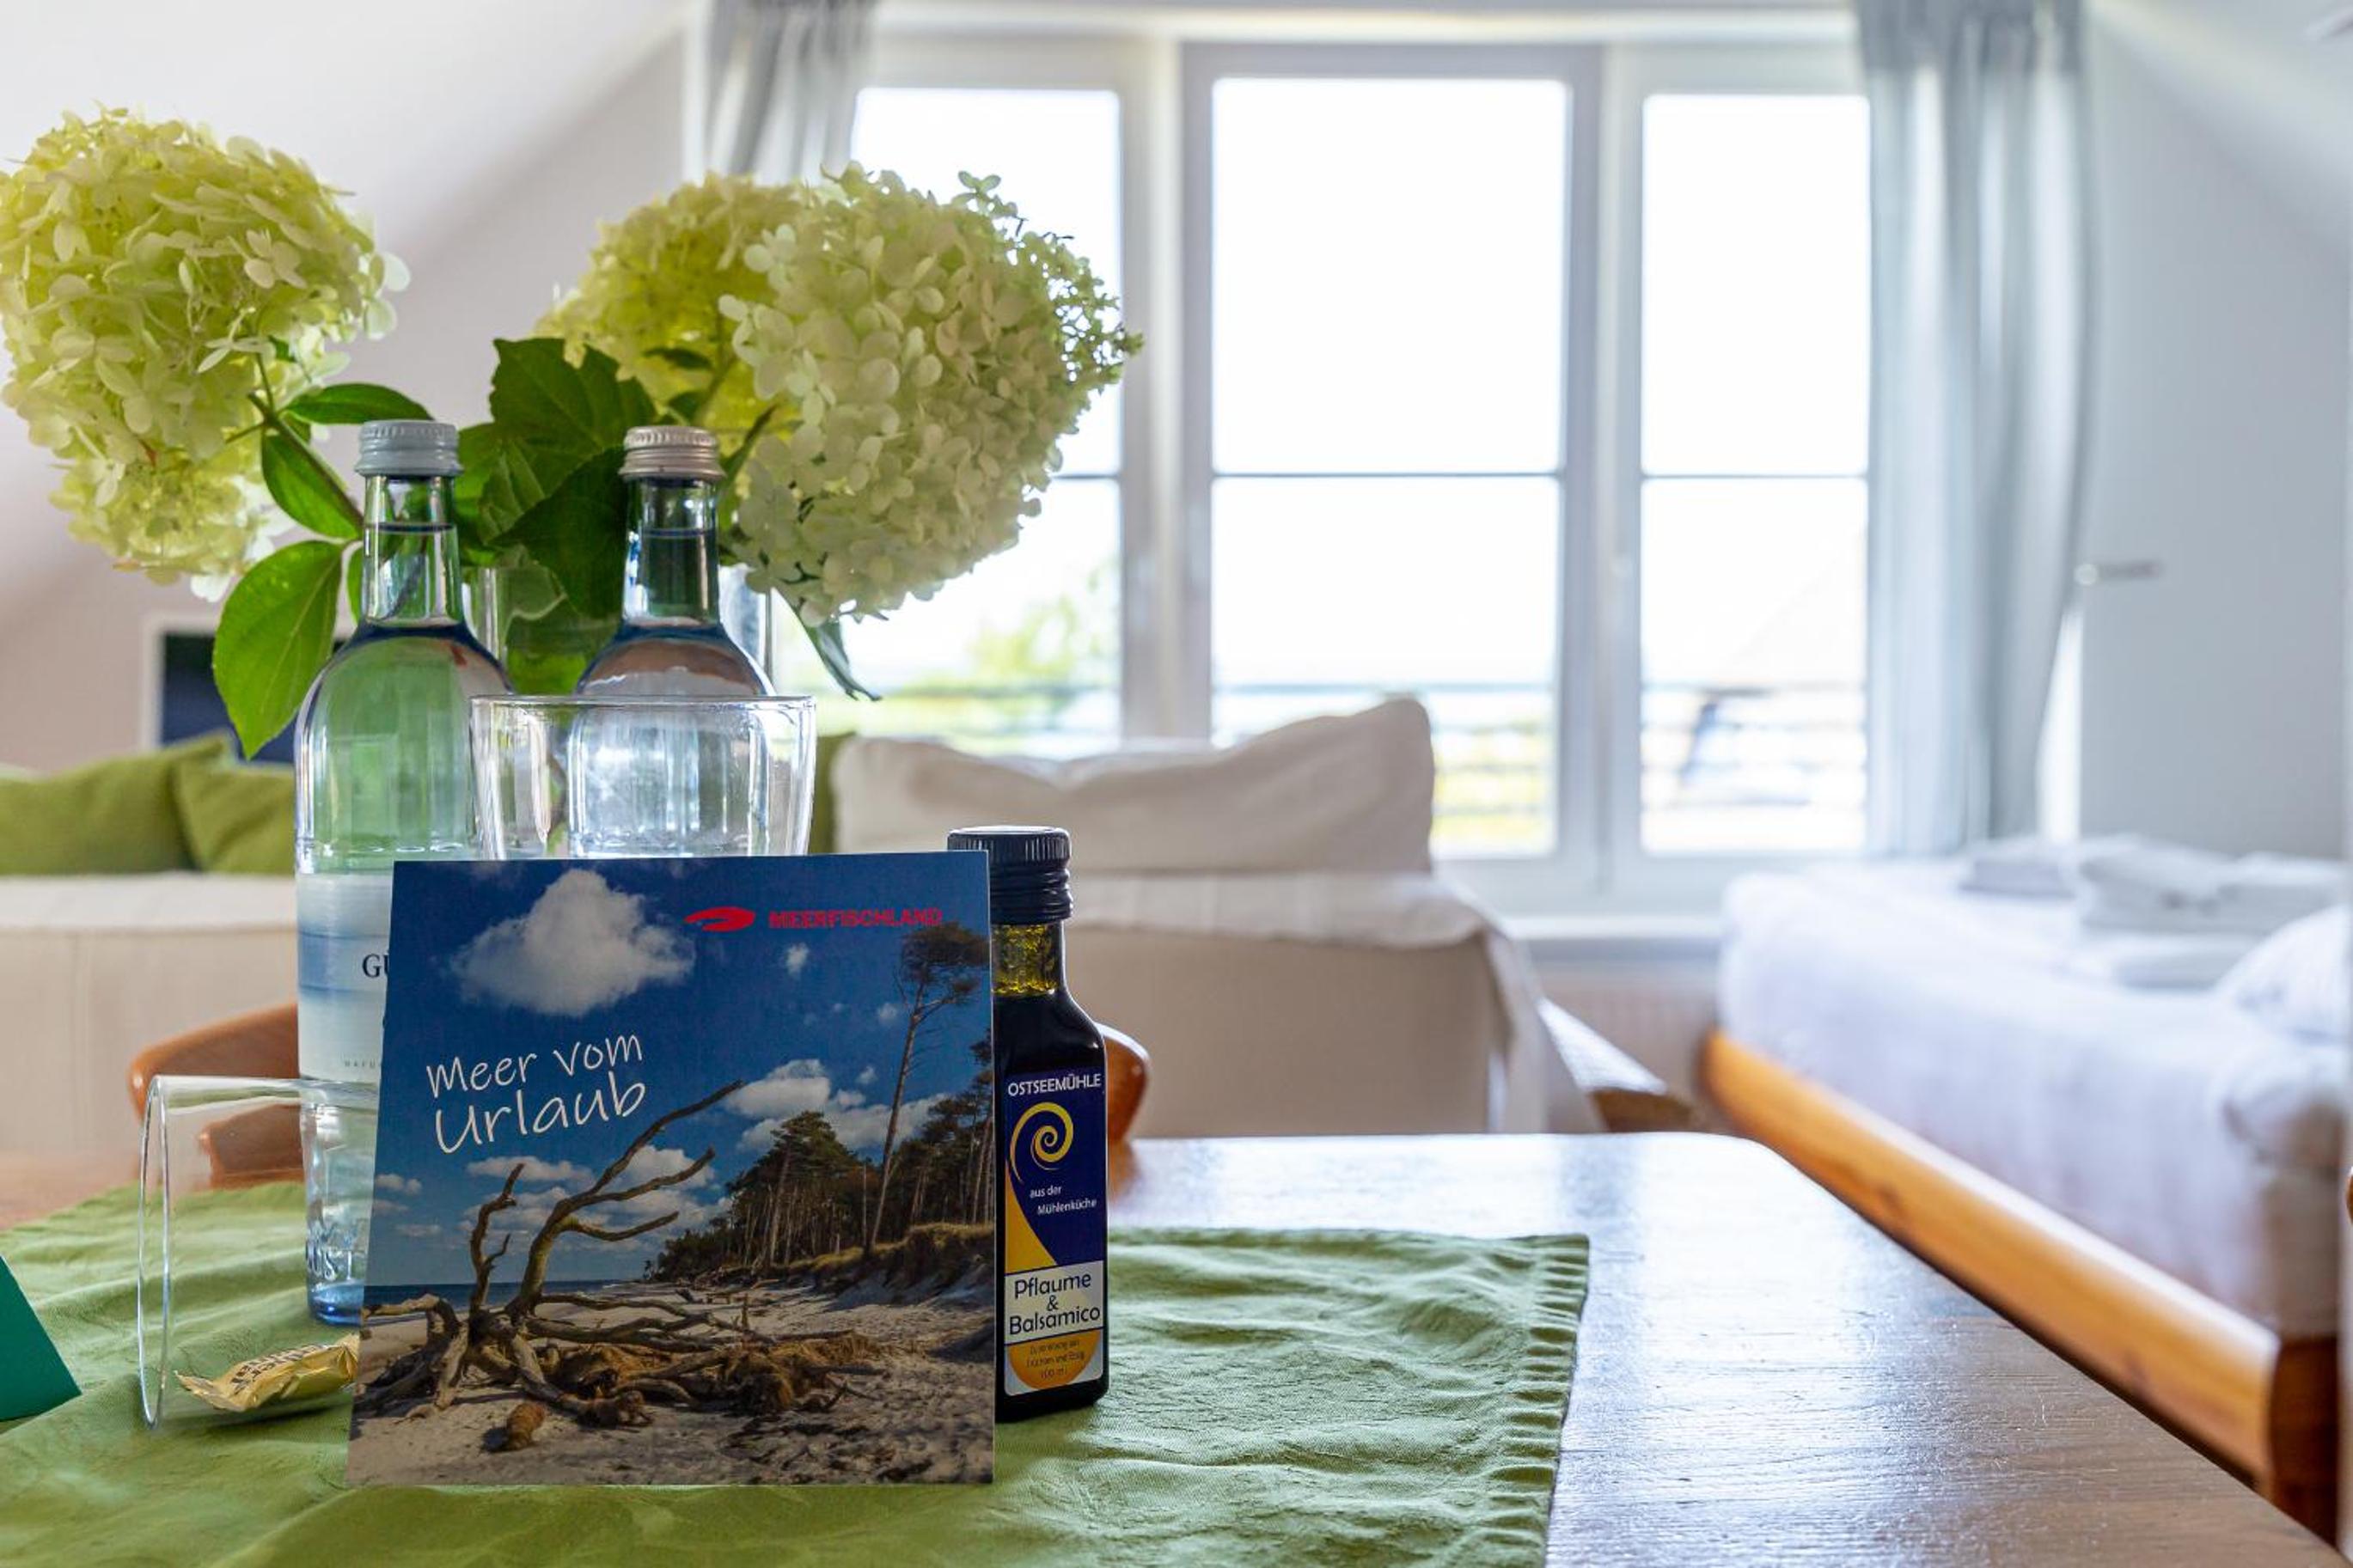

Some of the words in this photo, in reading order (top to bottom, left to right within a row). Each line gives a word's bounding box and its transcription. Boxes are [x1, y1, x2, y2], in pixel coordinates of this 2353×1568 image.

[768, 907, 943, 928] MEERFISCHLAND
[553, 1034, 643, 1076] vom
[1008, 1073, 1102, 1096] OSTSEEMÜHLE
[436, 1071, 645, 1153] Urlaub
[1030, 1188, 1046, 1199] aus
[1046, 1185, 1062, 1196] der
[1037, 1198, 1097, 1216] Mühlenküche
[1014, 1274, 1091, 1299] Pflaume
[1047, 1295, 1059, 1311] &
[1010, 1306, 1100, 1335] Balsamico
